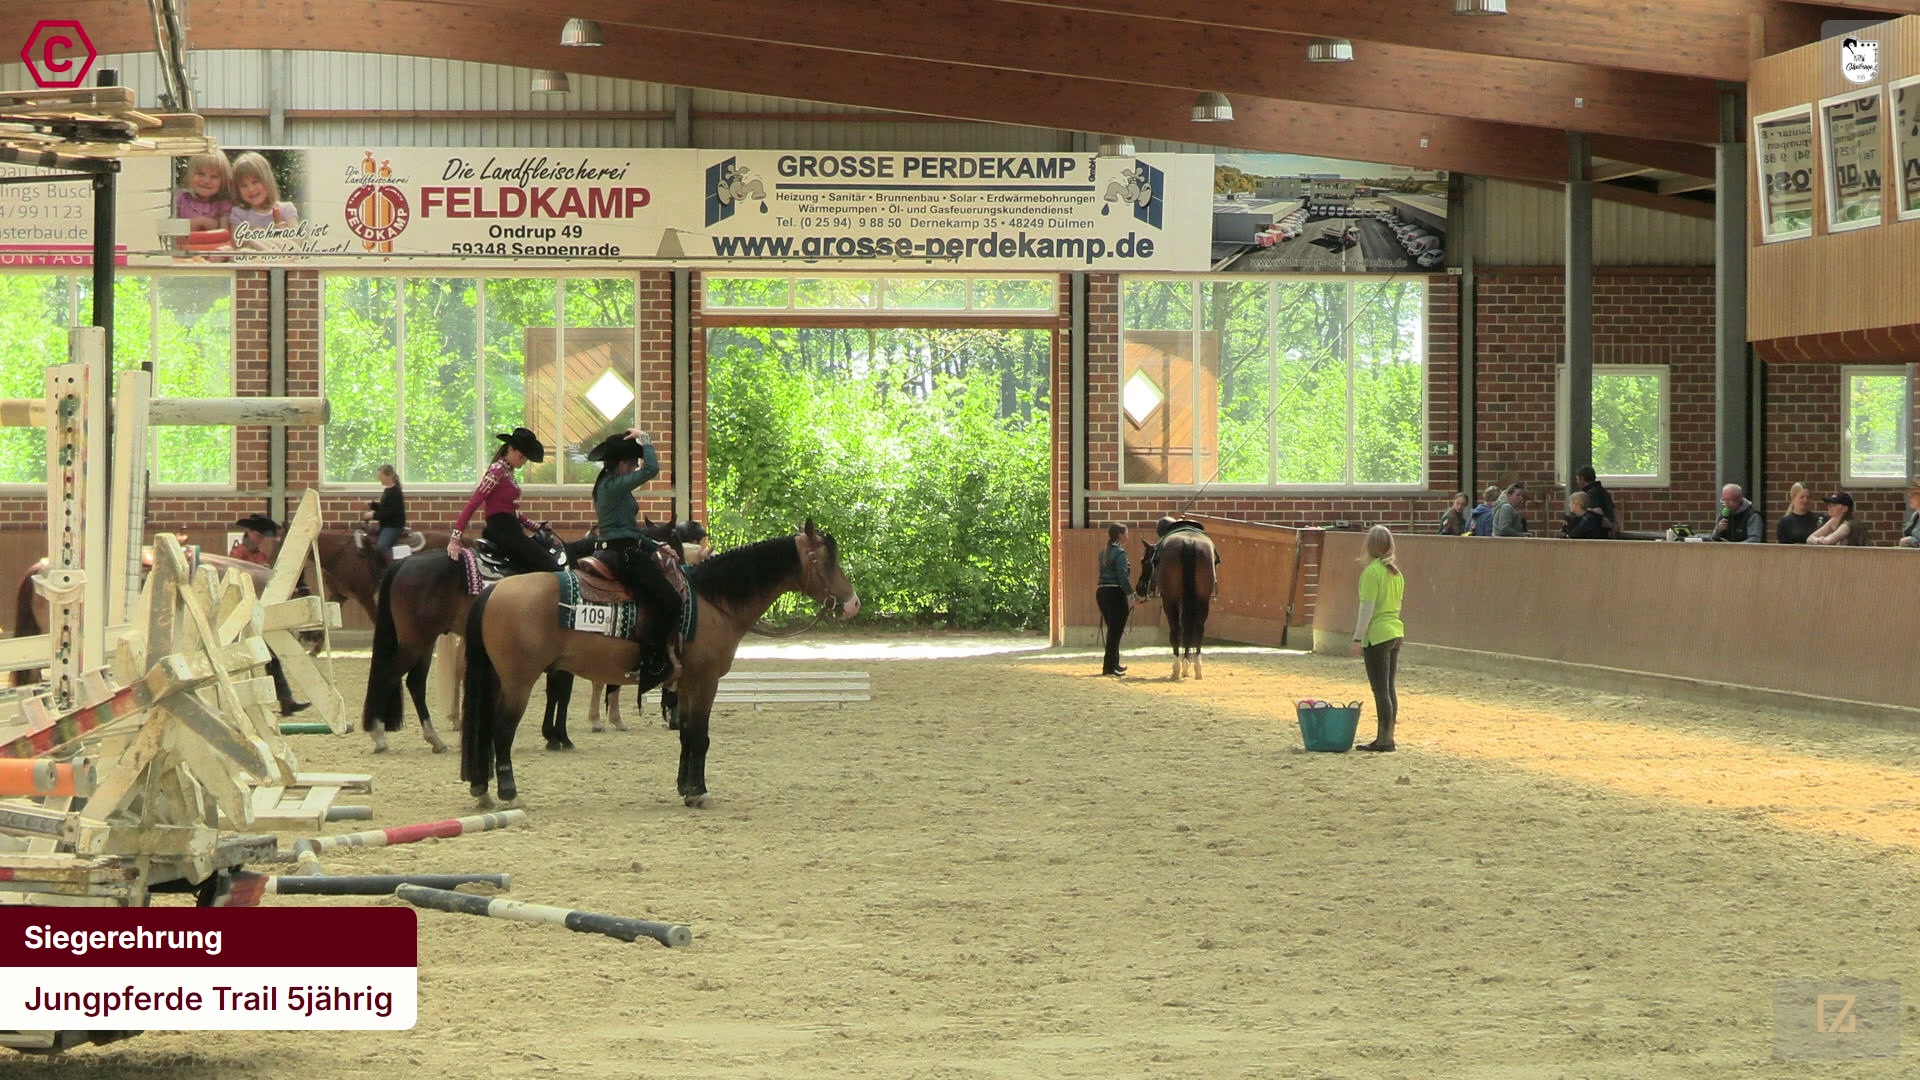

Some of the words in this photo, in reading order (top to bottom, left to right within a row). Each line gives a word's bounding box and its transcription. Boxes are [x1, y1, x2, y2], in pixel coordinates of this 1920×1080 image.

[442, 158, 475, 181] Die
[480, 157, 630, 188] Landfleischerei
[777, 155, 895, 178] GROSSE
[903, 156, 1076, 179] PERDEKAMP
[420, 187, 651, 219] FELDKAMP
[776, 193, 819, 203] Heizung
[828, 193, 866, 202] Sanitär
[876, 193, 940, 203] Brunnenbau
[950, 194, 977, 203] Solar
[986, 194, 1096, 204] Erdwärmebohrungen
[799, 204, 877, 215] Wärmepumpen
[907, 205, 927, 214] und
[930, 205, 1073, 216] Gasfeuerungskundendienst
[347, 207, 408, 240] FELDKAMP
[776, 217, 797, 228] Tel.
[910, 217, 979, 230] Dernekamp
[983, 218, 997, 228] 35
[1009, 218, 1044, 229] 48249
[1048, 218, 1095, 229] Dülmen
[0, 225, 88, 239] sterbau.de
[235, 221, 306, 246] Geschmack
[310, 223, 329, 237] ist
[489, 225, 556, 241] Ondrup
[561, 225, 583, 239] 49
[451, 243, 506, 255] 59348
[712, 231, 1155, 265] www.grosse-perdekamp.de
[581, 608, 605, 624] 109
